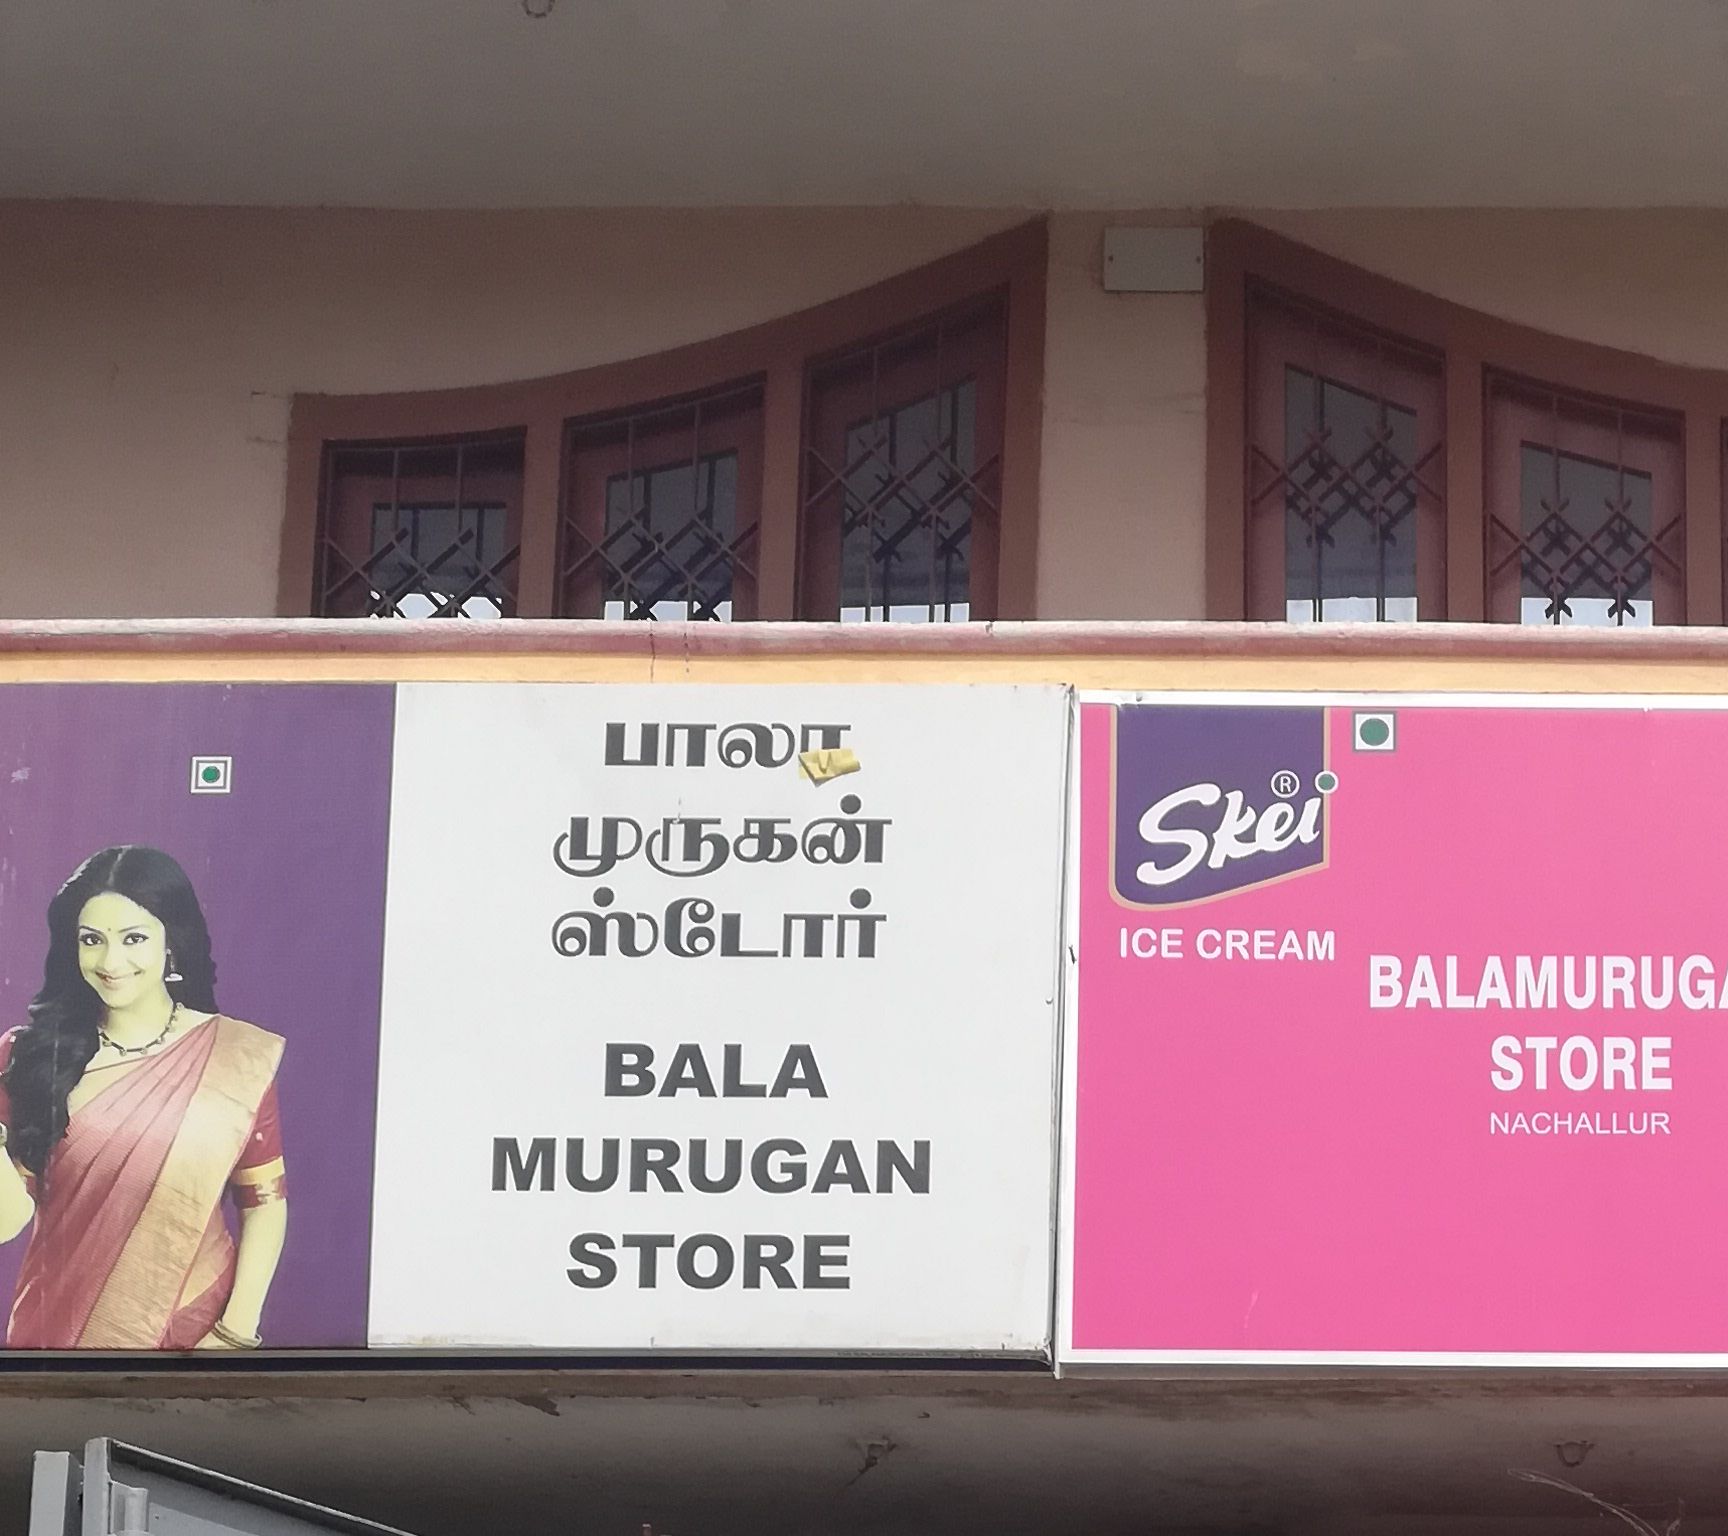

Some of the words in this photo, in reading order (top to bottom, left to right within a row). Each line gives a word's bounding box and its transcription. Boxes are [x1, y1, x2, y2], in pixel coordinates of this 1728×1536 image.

[604, 722, 852, 769] பாலா
[552, 793, 893, 878] முருகன்
[551, 886, 888, 958] ஸ்டோர்
[1120, 927, 1184, 959] ICE
[1195, 928, 1336, 961] CREAM
[604, 1042, 829, 1099] BALA
[1490, 1035, 1673, 1091] STORE
[1489, 1111, 1672, 1135] NACHALLUR
[491, 1136, 931, 1195] MURUGAN
[566, 1232, 851, 1290] STORE
